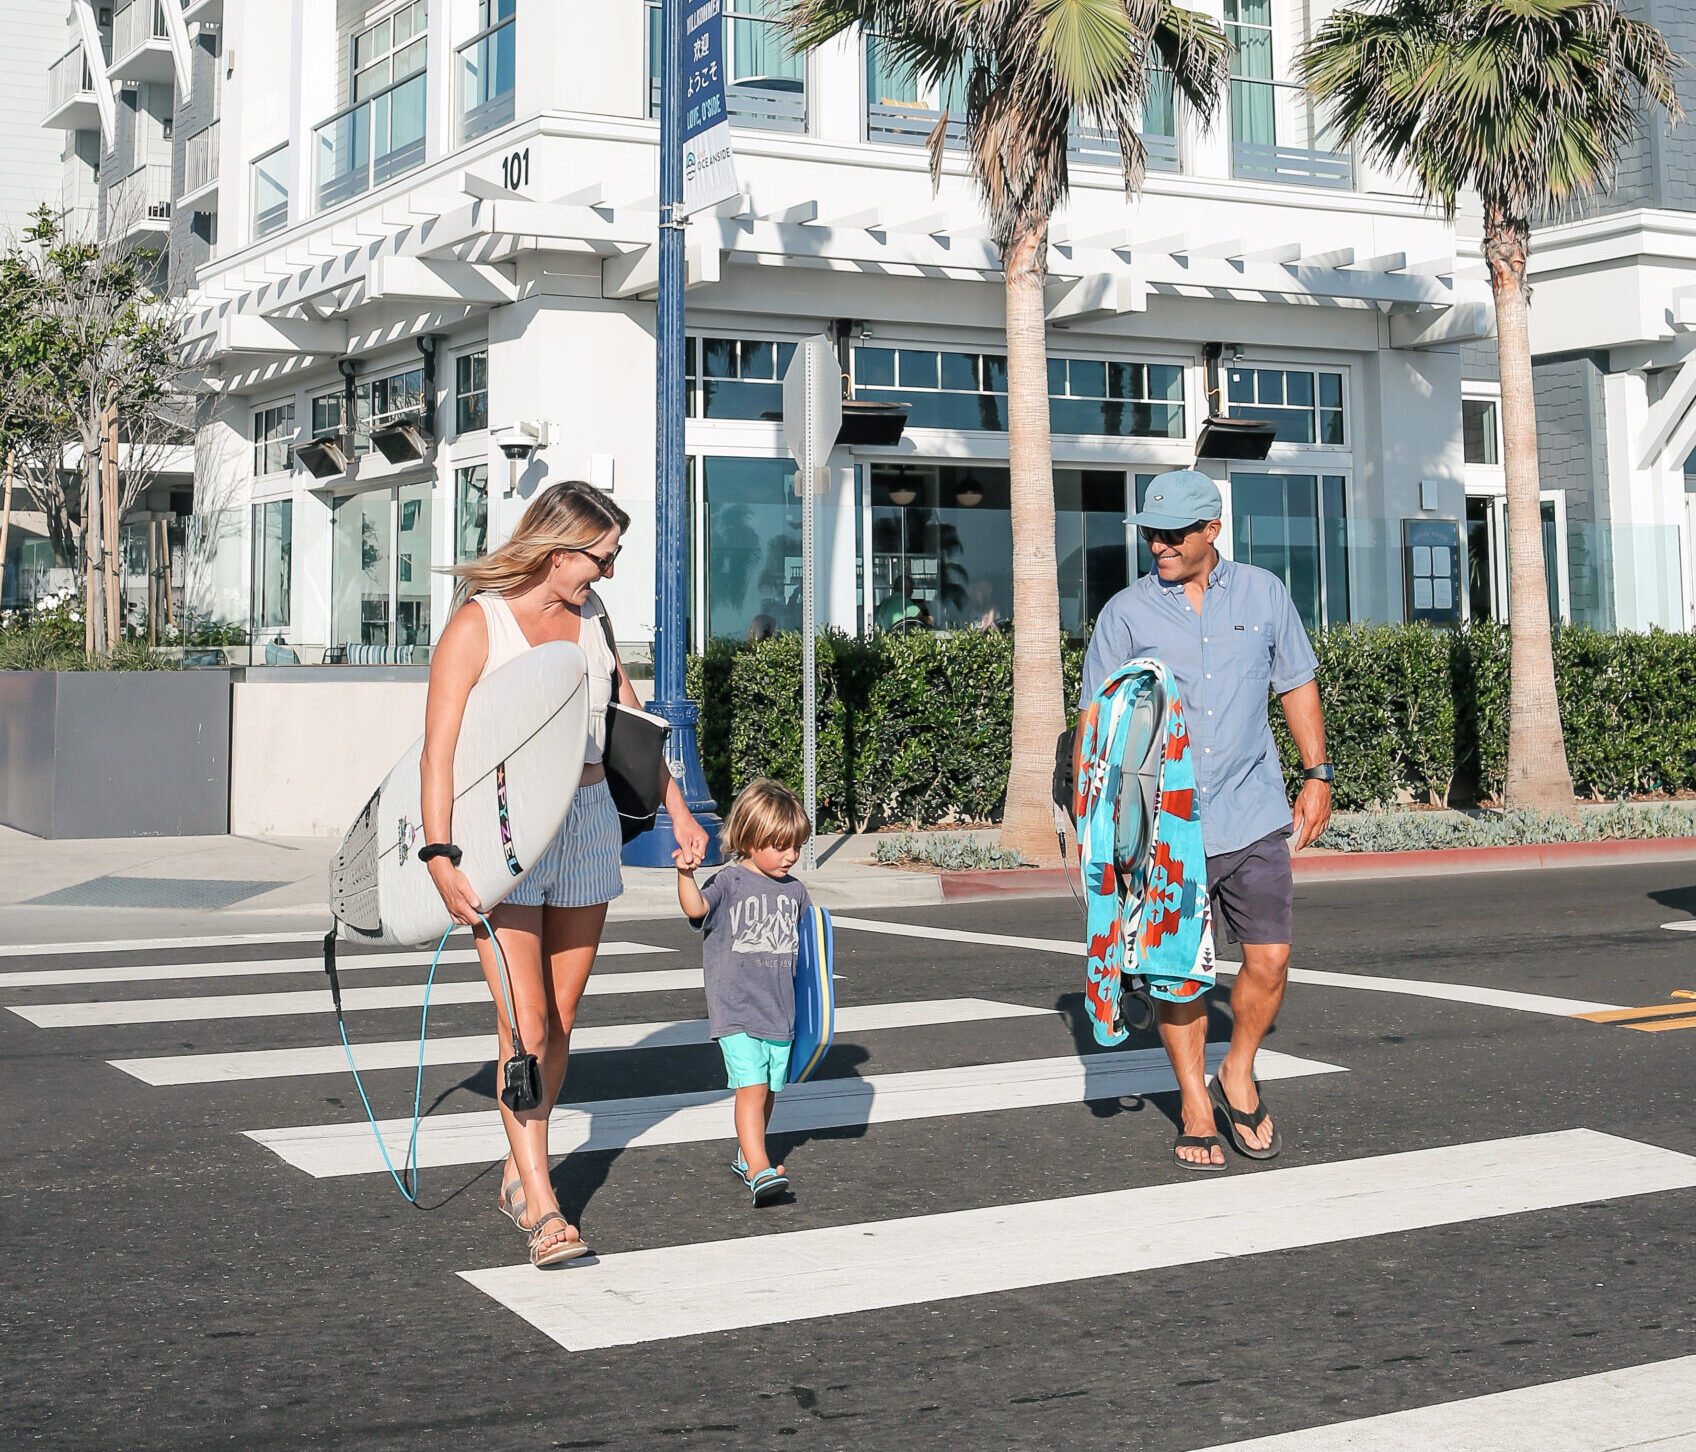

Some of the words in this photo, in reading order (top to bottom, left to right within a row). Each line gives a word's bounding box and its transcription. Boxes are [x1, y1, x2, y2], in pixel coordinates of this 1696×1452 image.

[687, 60, 718, 98] ようこそ
[502, 147, 529, 191] 101
[697, 147, 731, 170] OCEANSIDE
[498, 785, 516, 876] PYZEL
[729, 893, 799, 936] VOLCO
